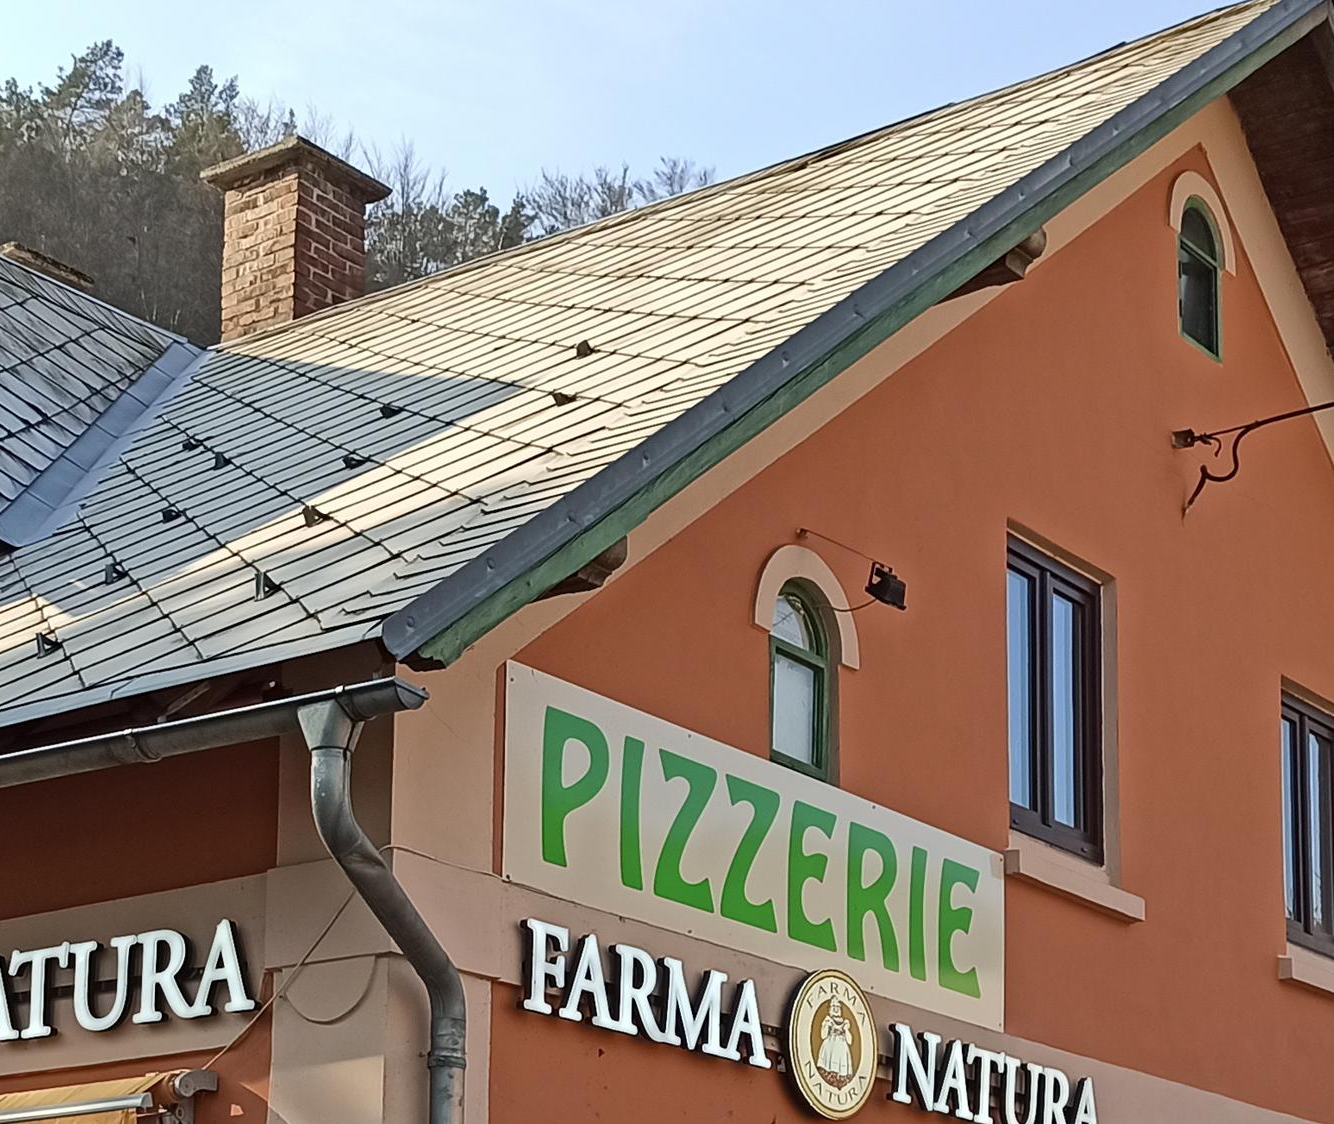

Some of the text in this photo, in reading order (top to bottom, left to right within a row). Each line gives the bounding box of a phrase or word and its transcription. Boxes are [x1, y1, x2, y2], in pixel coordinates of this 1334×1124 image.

[541, 705, 982, 999] PIZZERIE
[524, 918, 771, 1069] FARMA
[806, 982, 866, 1027] FARMA
[805, 1060, 867, 1106] NATURA
